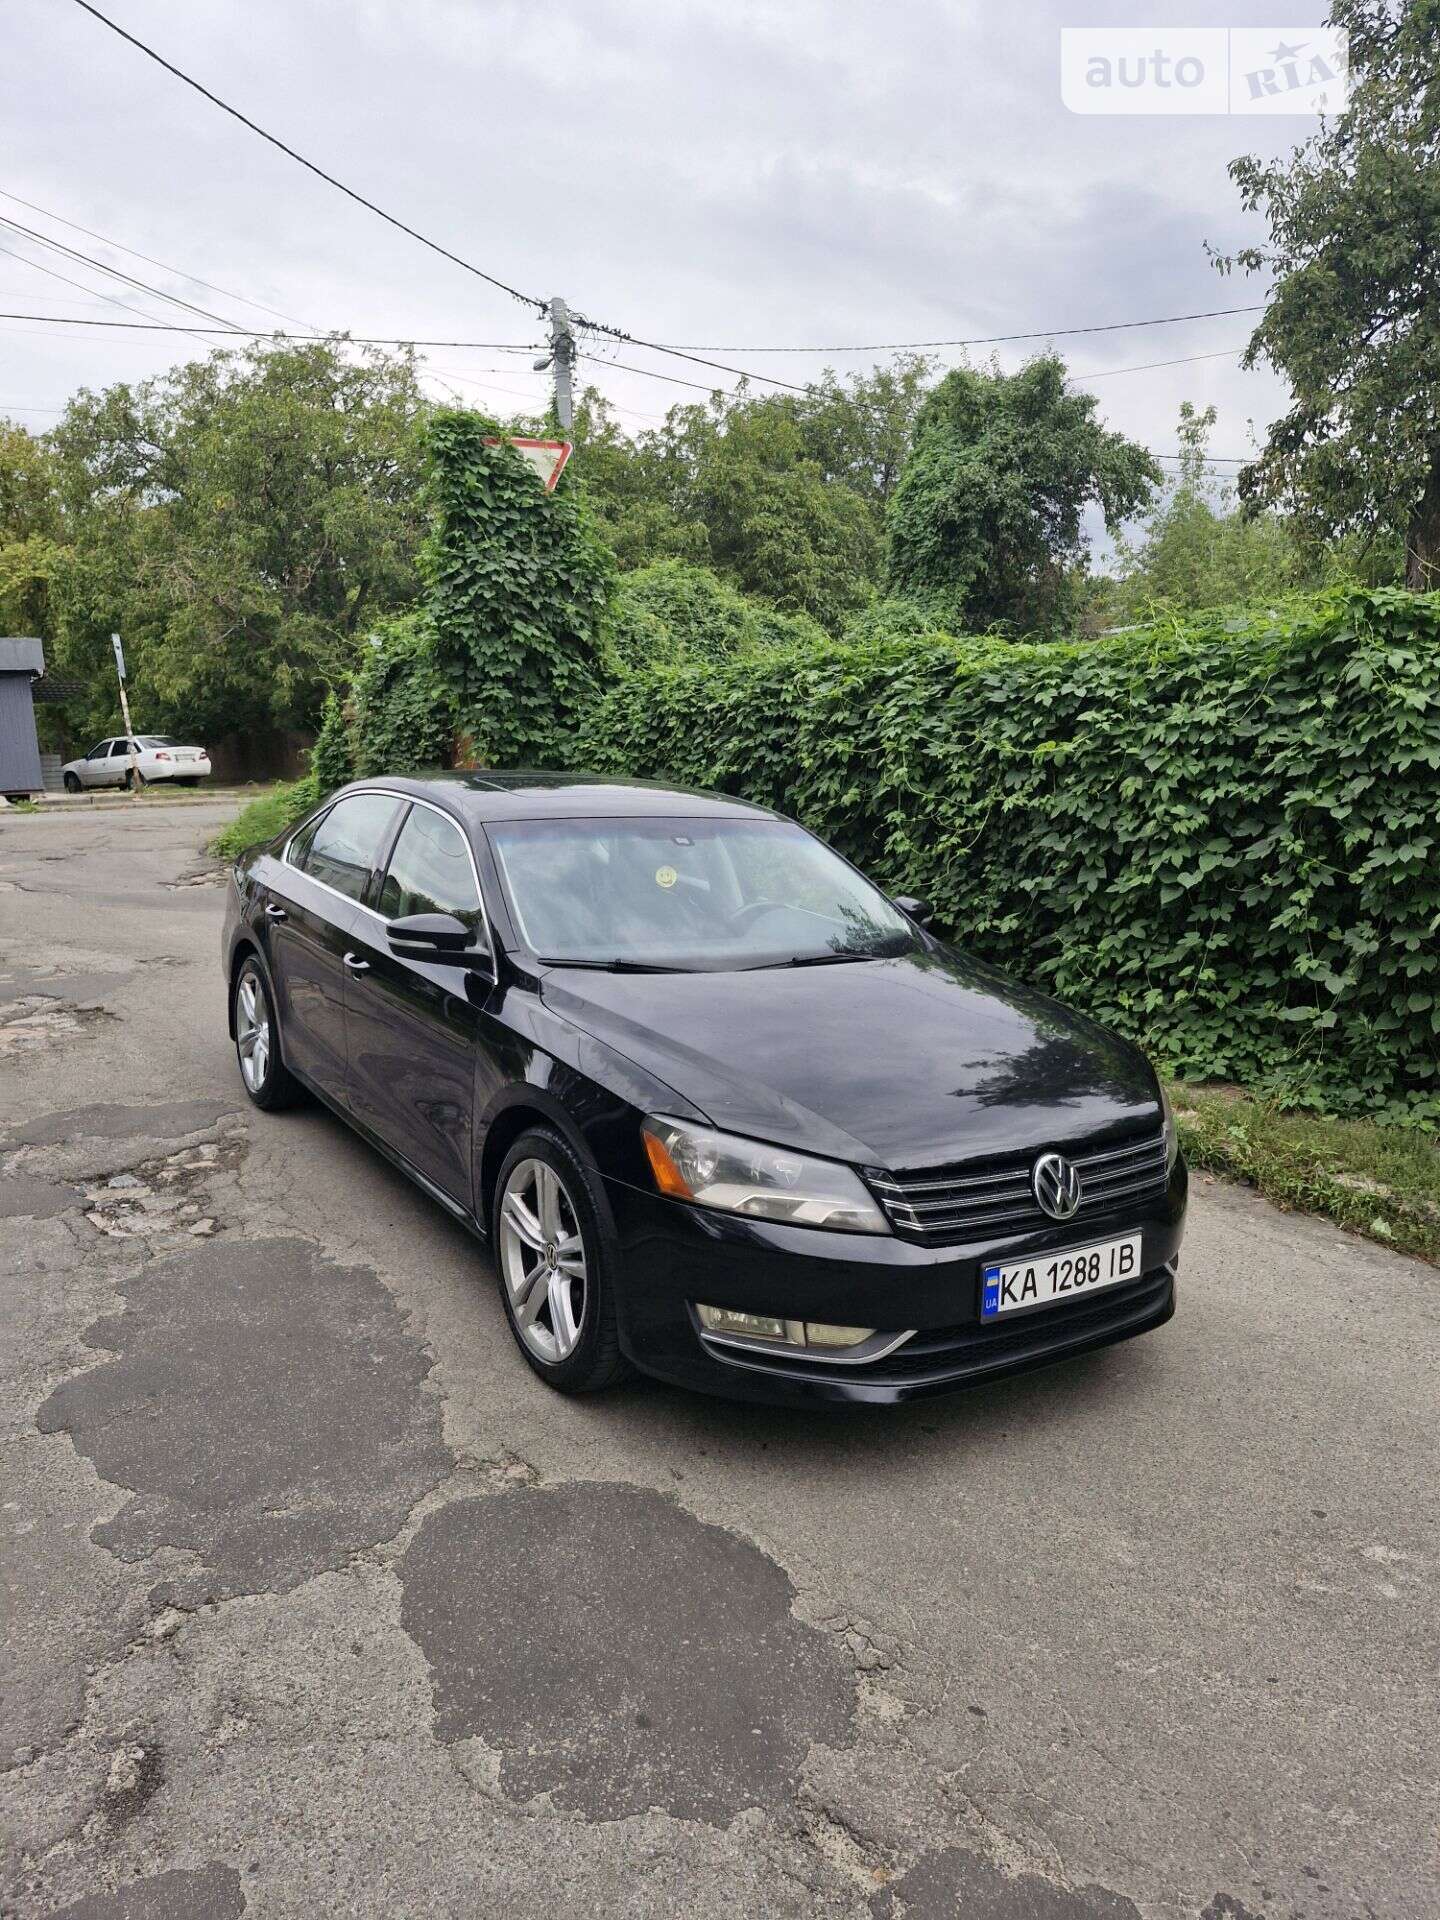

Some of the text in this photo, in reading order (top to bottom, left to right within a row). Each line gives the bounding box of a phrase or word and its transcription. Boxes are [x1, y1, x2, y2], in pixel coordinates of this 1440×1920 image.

[1001, 1243, 1134, 1305] KA 1288 IB
[986, 1298, 997, 1309] UA
